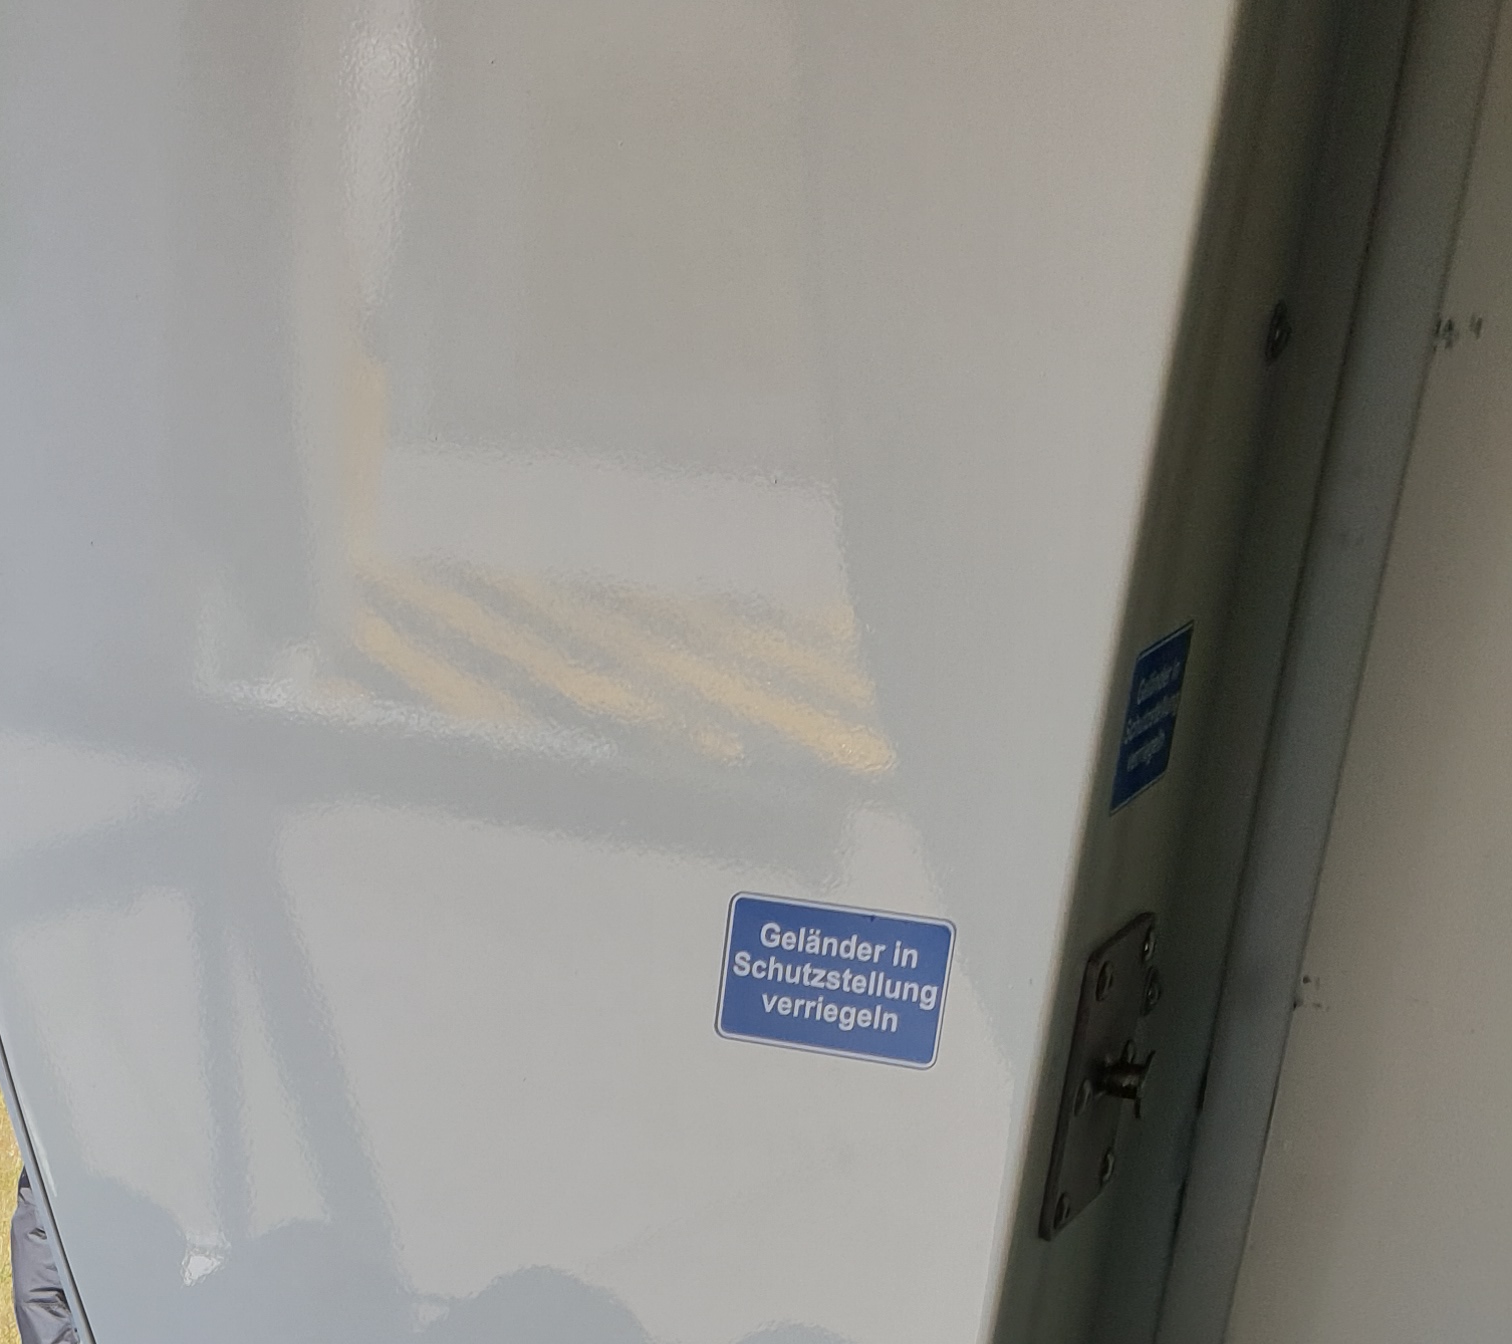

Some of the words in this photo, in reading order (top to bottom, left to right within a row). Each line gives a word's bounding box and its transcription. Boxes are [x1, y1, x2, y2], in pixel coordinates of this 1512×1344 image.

[759, 922, 886, 964] Geländer
[892, 940, 918, 969] in
[732, 951, 939, 1011] Schutzstellung
[761, 992, 899, 1033] verriegeln
